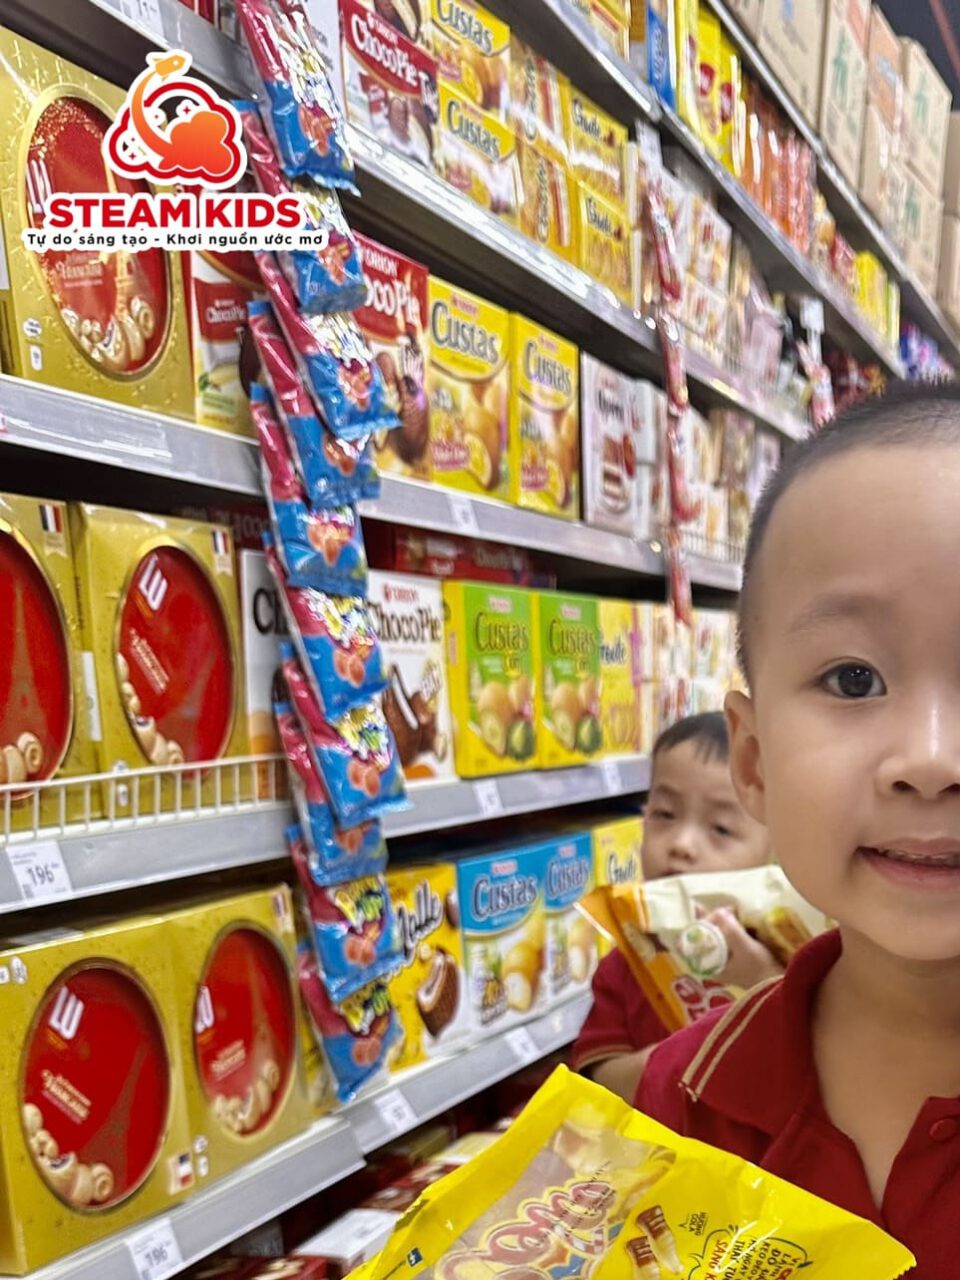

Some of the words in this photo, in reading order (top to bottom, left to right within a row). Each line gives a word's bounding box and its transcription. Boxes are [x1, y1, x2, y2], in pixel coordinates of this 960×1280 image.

[446, 98, 500, 163] Custas
[432, 301, 499, 364] Custas
[526, 341, 572, 396] Custas
[474, 612, 529, 650] Custas
[549, 618, 597, 655] Custas
[550, 851, 589, 891] Custas
[473, 873, 538, 919] Custas
